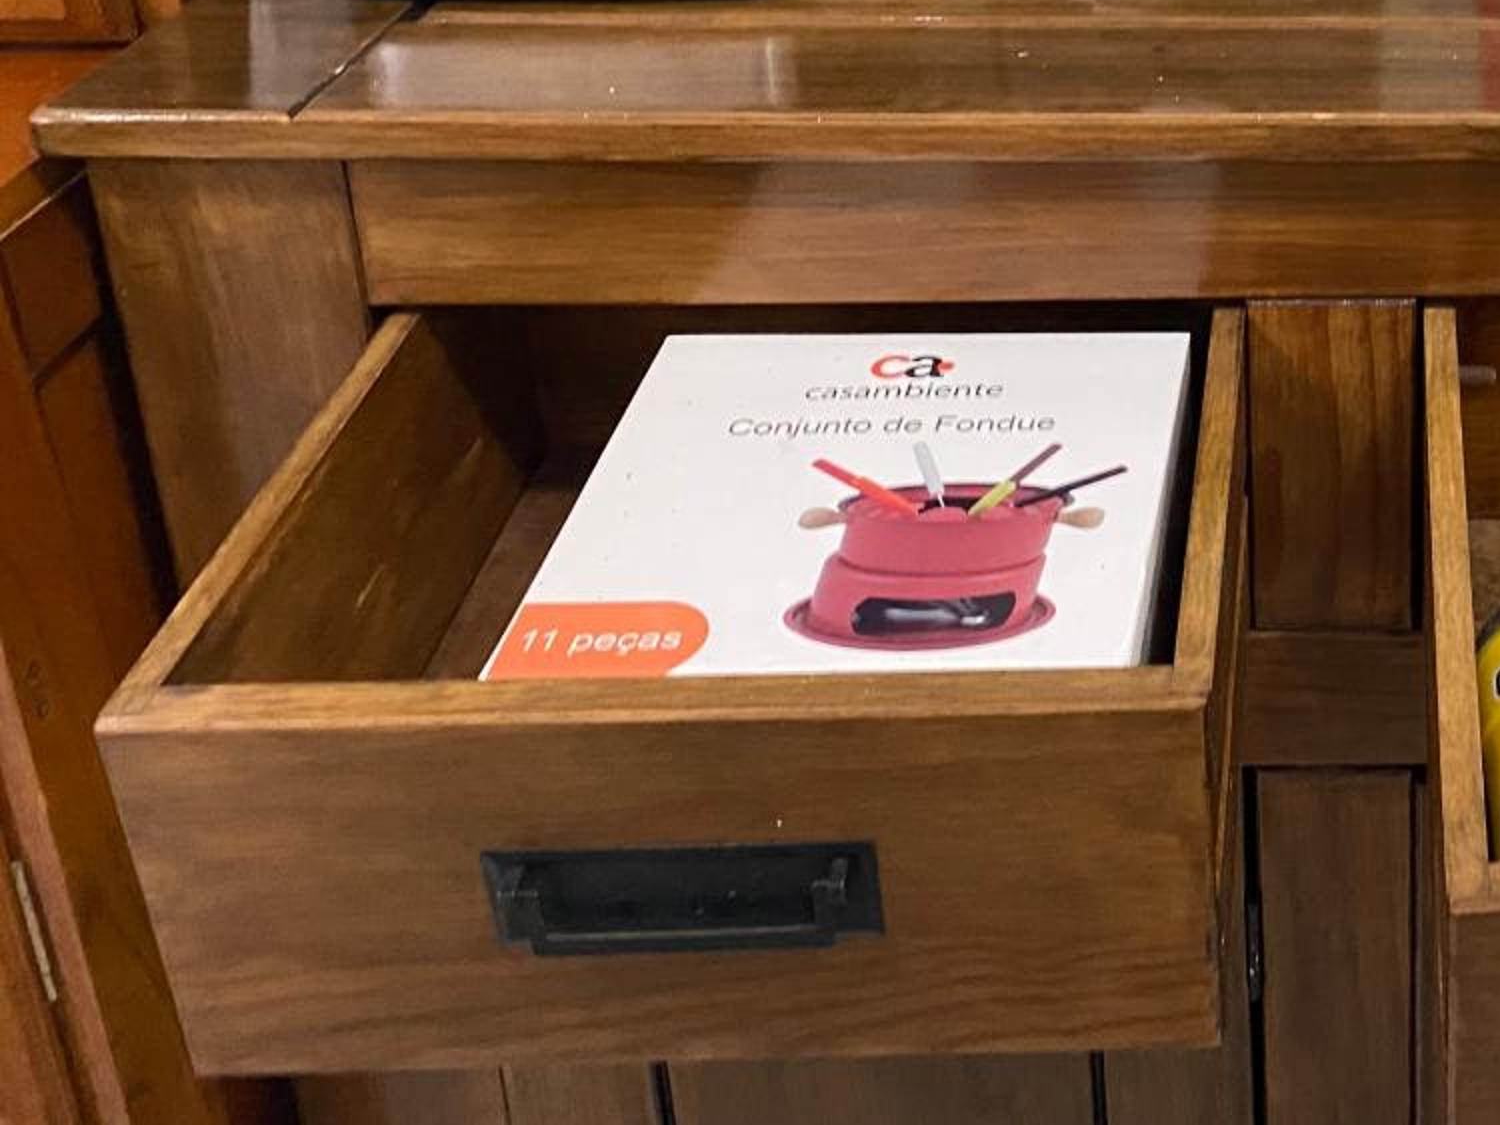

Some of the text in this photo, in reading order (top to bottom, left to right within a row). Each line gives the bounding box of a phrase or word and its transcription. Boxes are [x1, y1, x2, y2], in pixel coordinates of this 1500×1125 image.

[804, 380, 1005, 401] casambiente
[728, 413, 1057, 439] Conjunto de Fondue
[522, 627, 684, 659] 11 peças
